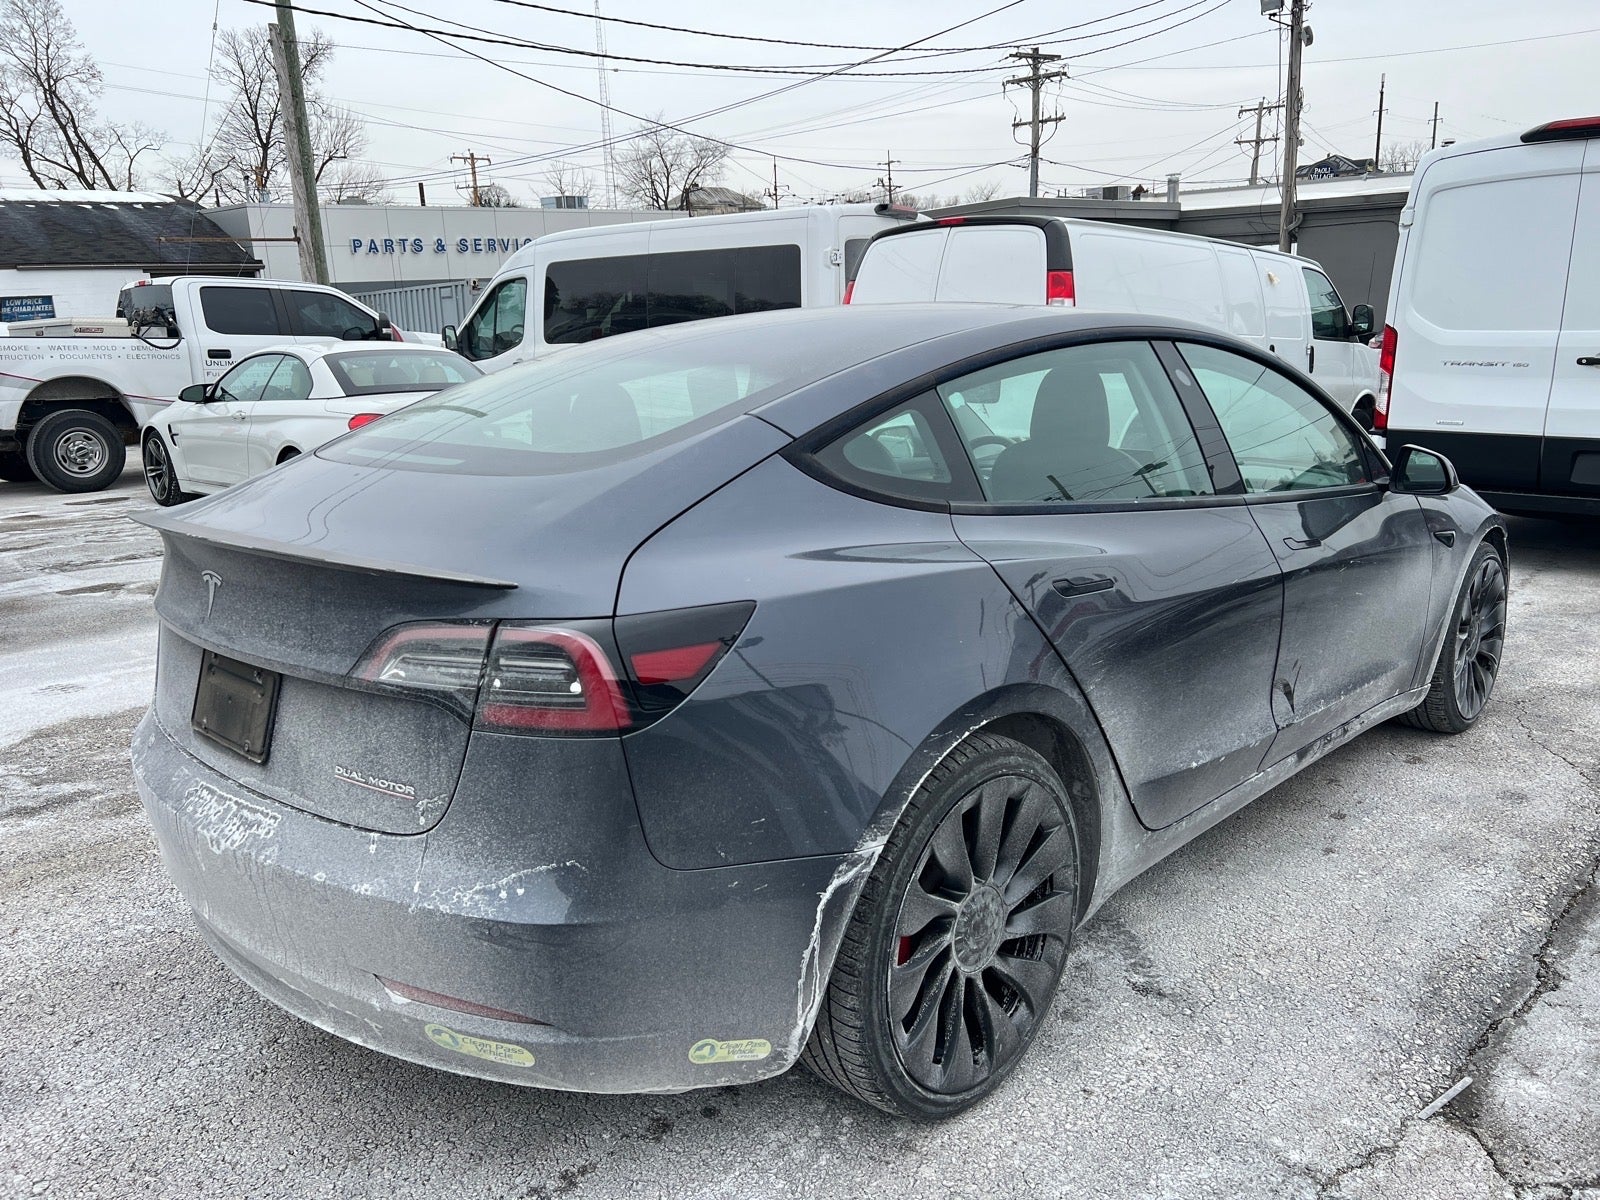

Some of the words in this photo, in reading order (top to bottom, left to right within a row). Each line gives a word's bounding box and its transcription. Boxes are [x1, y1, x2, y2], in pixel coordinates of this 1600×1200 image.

[351, 238, 424, 253] PARTS
[436, 238, 447, 252] &
[12, 304, 53, 312] GUARANTEE
[334, 765, 366, 782] DUAL
[369, 776, 415, 795] MOTOR
[462, 1037, 492, 1050] Clean
[495, 1043, 525, 1055] Pass
[475, 1044, 514, 1060] Vehicle
